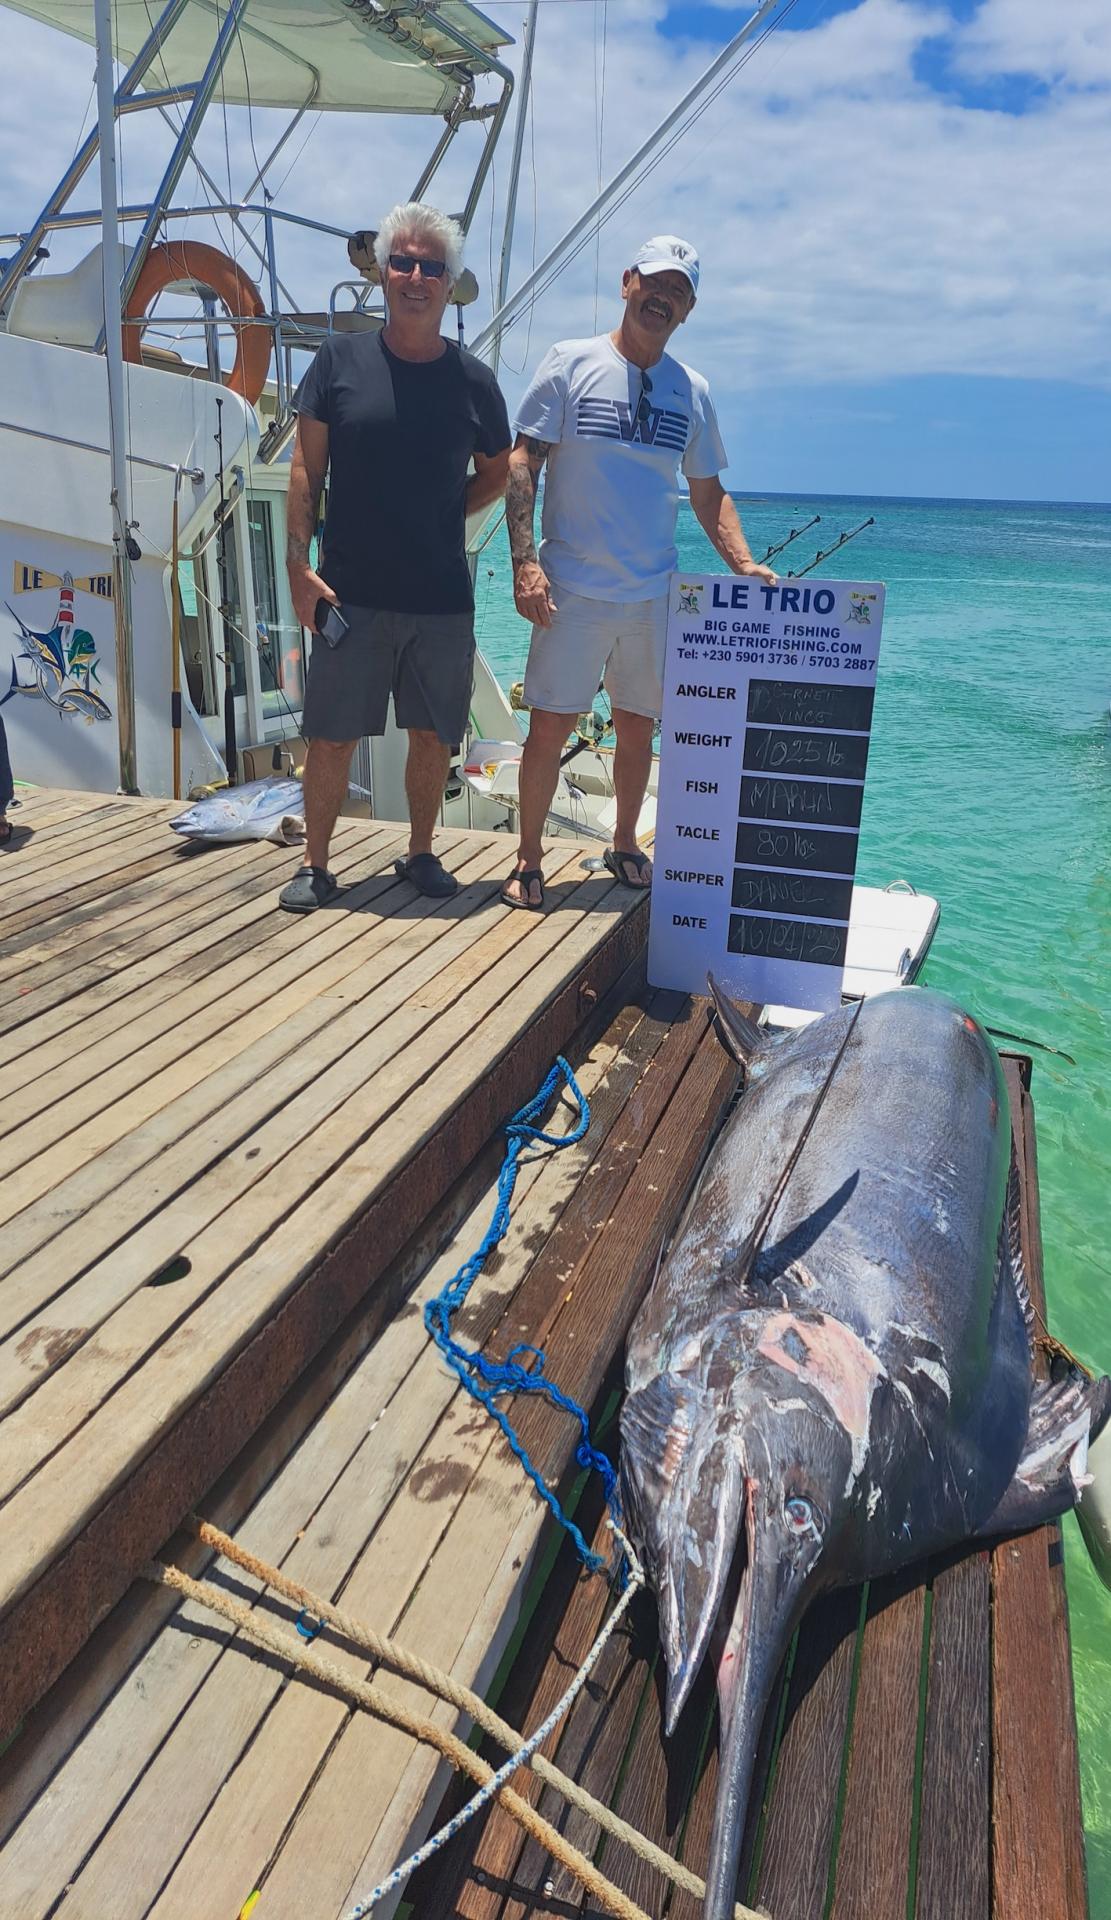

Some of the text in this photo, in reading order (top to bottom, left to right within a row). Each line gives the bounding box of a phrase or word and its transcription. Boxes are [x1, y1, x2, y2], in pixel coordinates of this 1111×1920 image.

[670, 244, 688, 260] W
[613, 400, 665, 445] W
[23, 566, 112, 598] LE TRI
[712, 583, 835, 614] LE TRIO
[704, 620, 840, 638] BIG GAME FISHING
[682, 632, 862, 655] WWW.LETRIOFISHING.COM
[677, 648, 875, 671] Tel: +230 5901 3736 / 5703 2887
[676, 684, 736, 700] ANGLER
[674, 731, 732, 748] WEIGHT
[685, 780, 718, 794] FISH
[676, 825, 720, 841] TACLE
[757, 830, 788, 856] 80
[664, 869, 724, 887] SKIPPER
[672, 914, 707, 929] DATE
